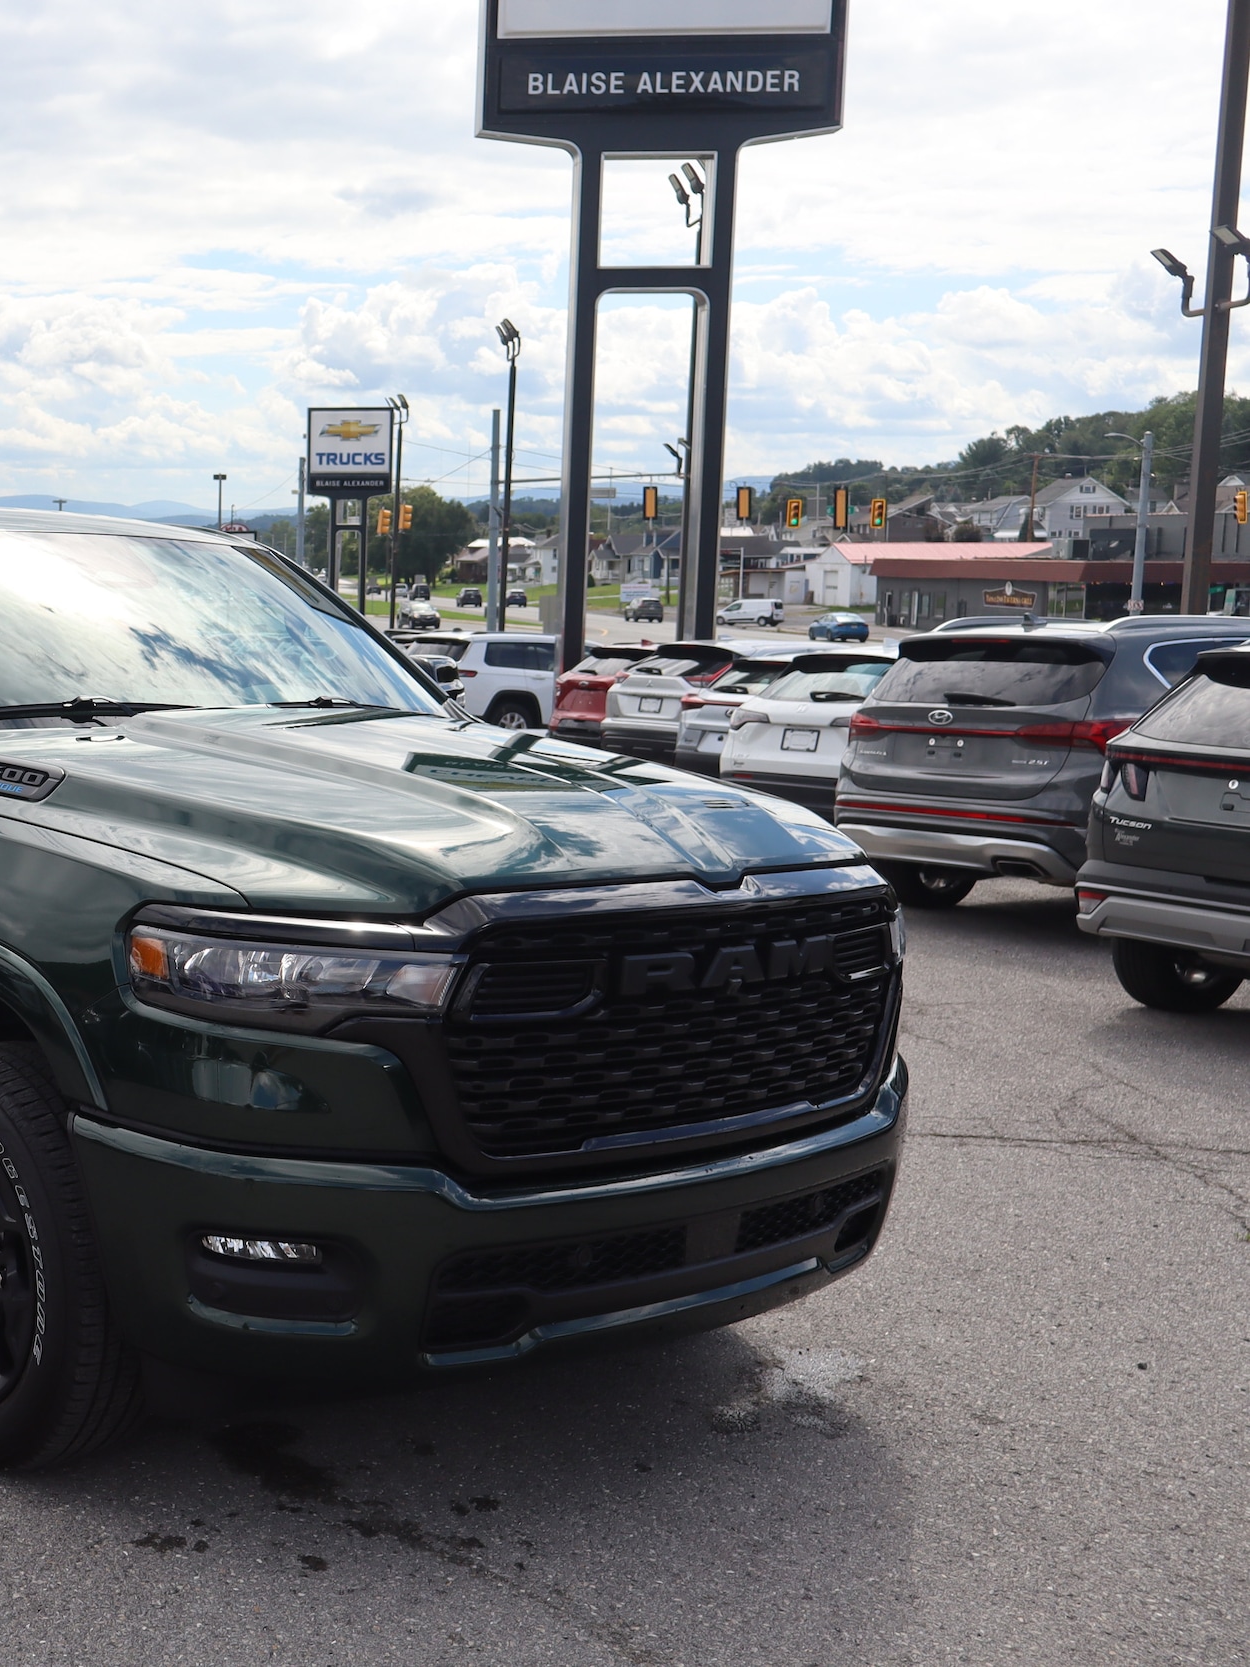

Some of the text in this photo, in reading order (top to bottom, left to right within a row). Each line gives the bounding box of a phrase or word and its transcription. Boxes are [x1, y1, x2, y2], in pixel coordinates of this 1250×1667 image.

[528, 70, 800, 95] BLAISE ALEXANDER
[315, 452, 386, 466] TRUCKS
[619, 935, 832, 996] RAM
